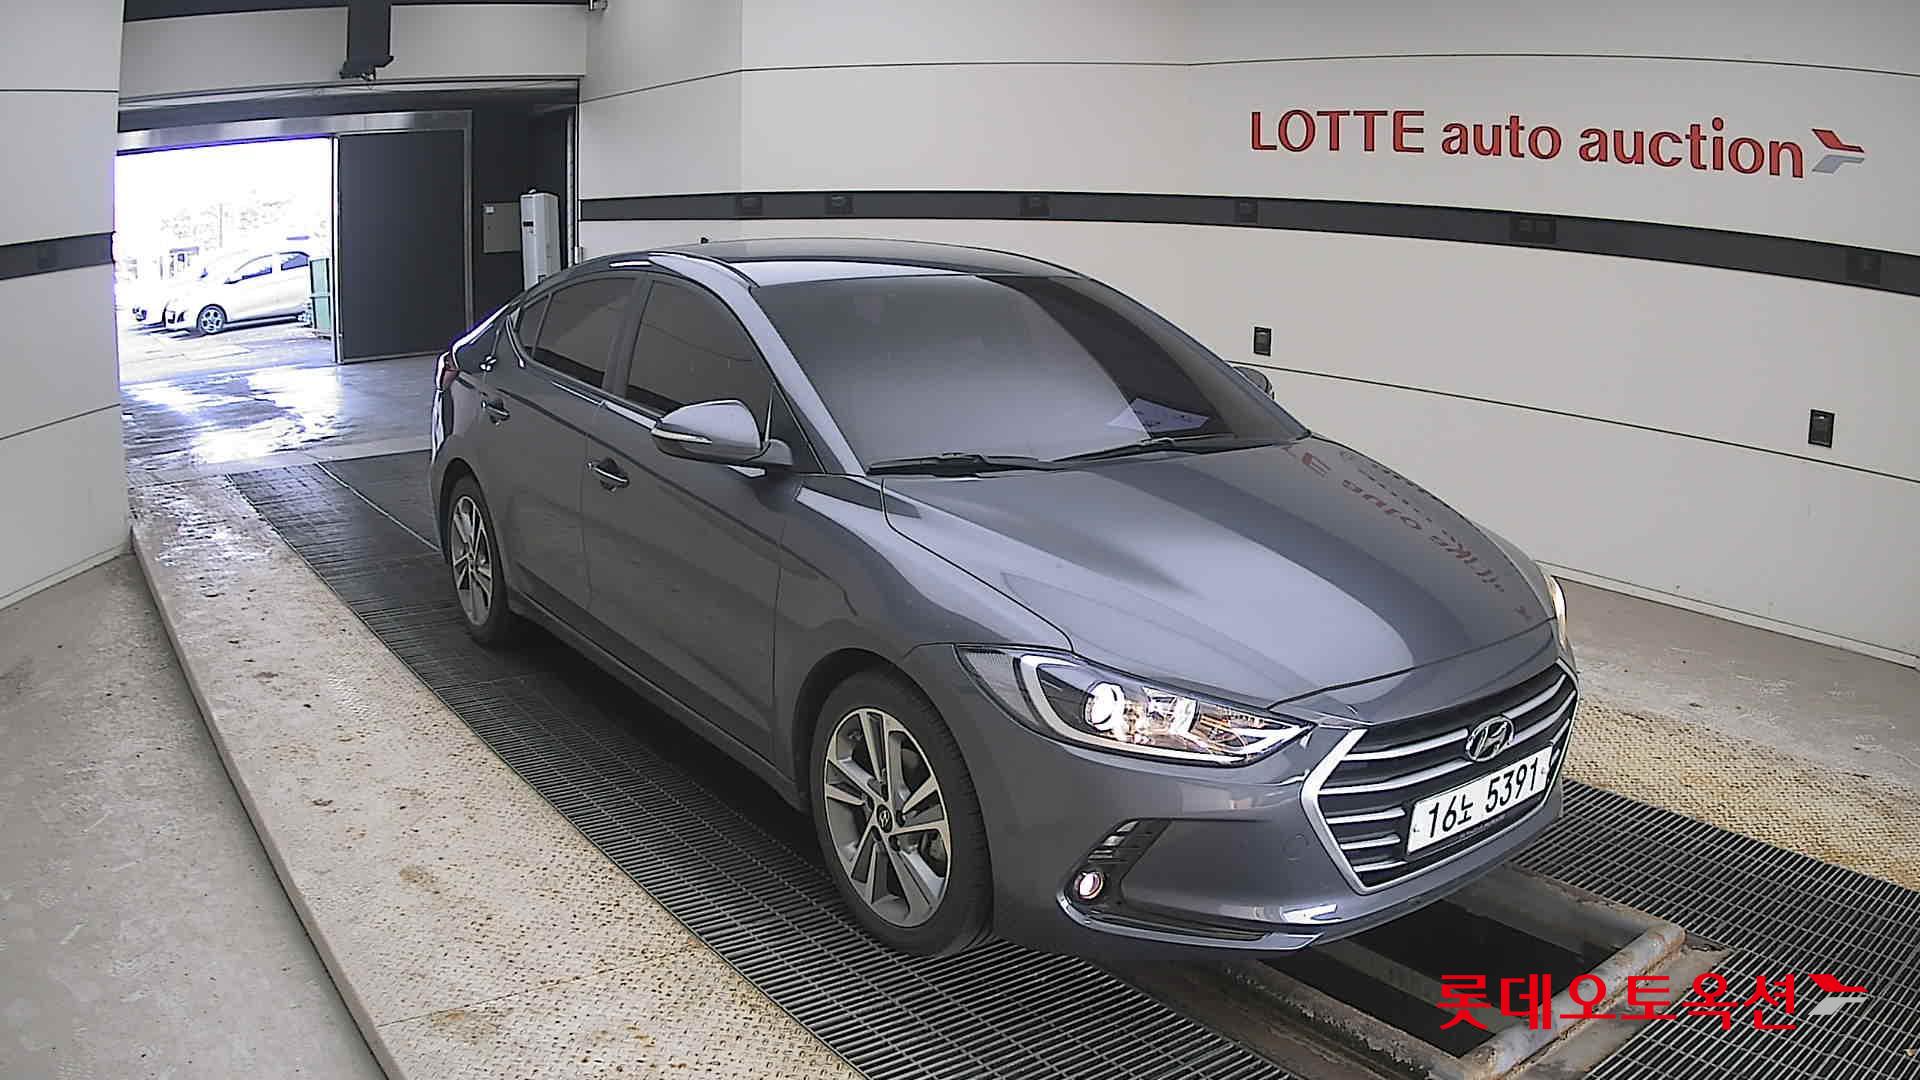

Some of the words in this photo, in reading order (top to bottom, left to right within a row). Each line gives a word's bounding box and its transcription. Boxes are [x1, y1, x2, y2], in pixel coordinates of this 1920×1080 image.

[1250, 109, 1425, 153] LOTTE
[1440, 114, 1562, 161] auto
[1577, 116, 1804, 179] auction
[1428, 794, 1474, 839] 16노
[1485, 757, 1538, 813] 5391
